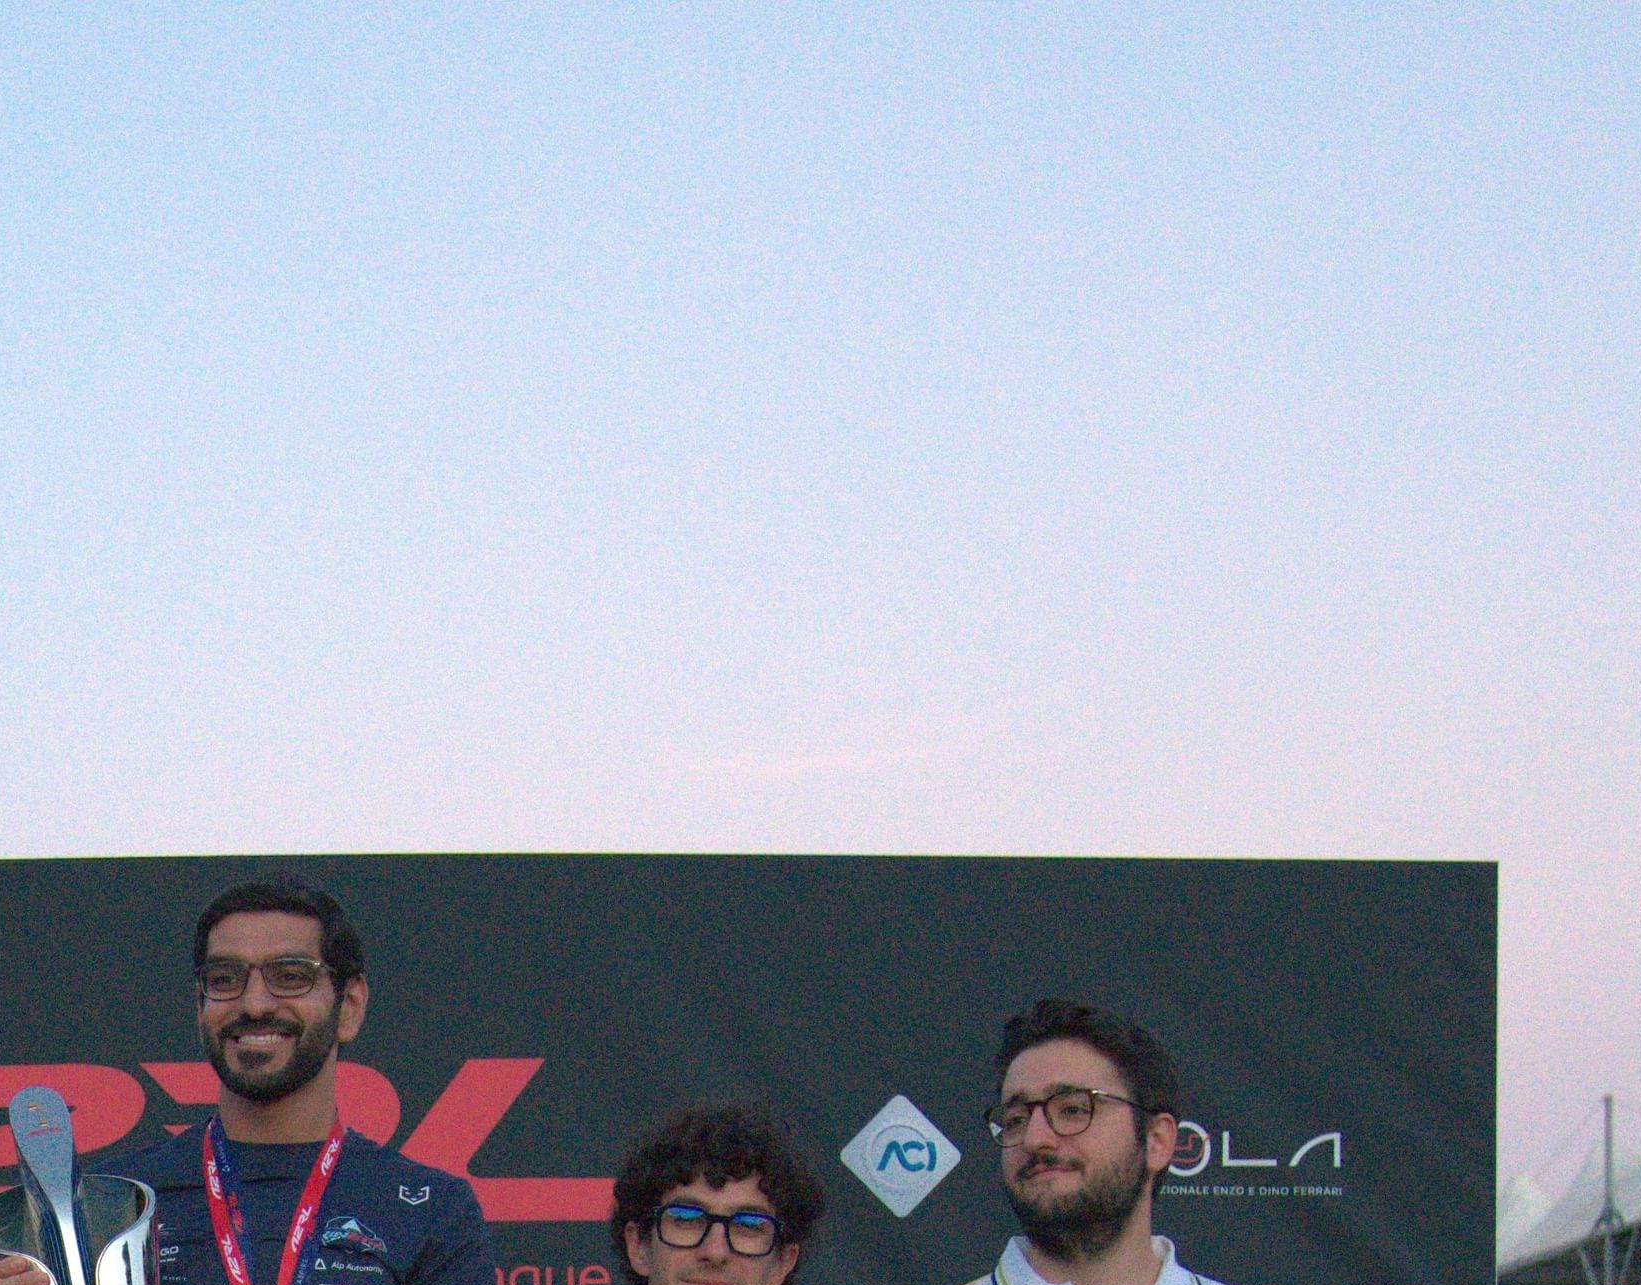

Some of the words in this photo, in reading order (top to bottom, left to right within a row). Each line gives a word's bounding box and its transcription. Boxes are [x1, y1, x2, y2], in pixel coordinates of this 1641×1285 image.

[876, 1140, 937, 1172] ACI
[1168, 1120, 1341, 1177] OLA
[1159, 1185, 1209, 1196] ZIONALE
[1213, 1186, 1244, 1196] ENZO
[1248, 1186, 1255, 1196] E
[1259, 1186, 1289, 1196] DINO
[1293, 1186, 1343, 1196] FERRARI
